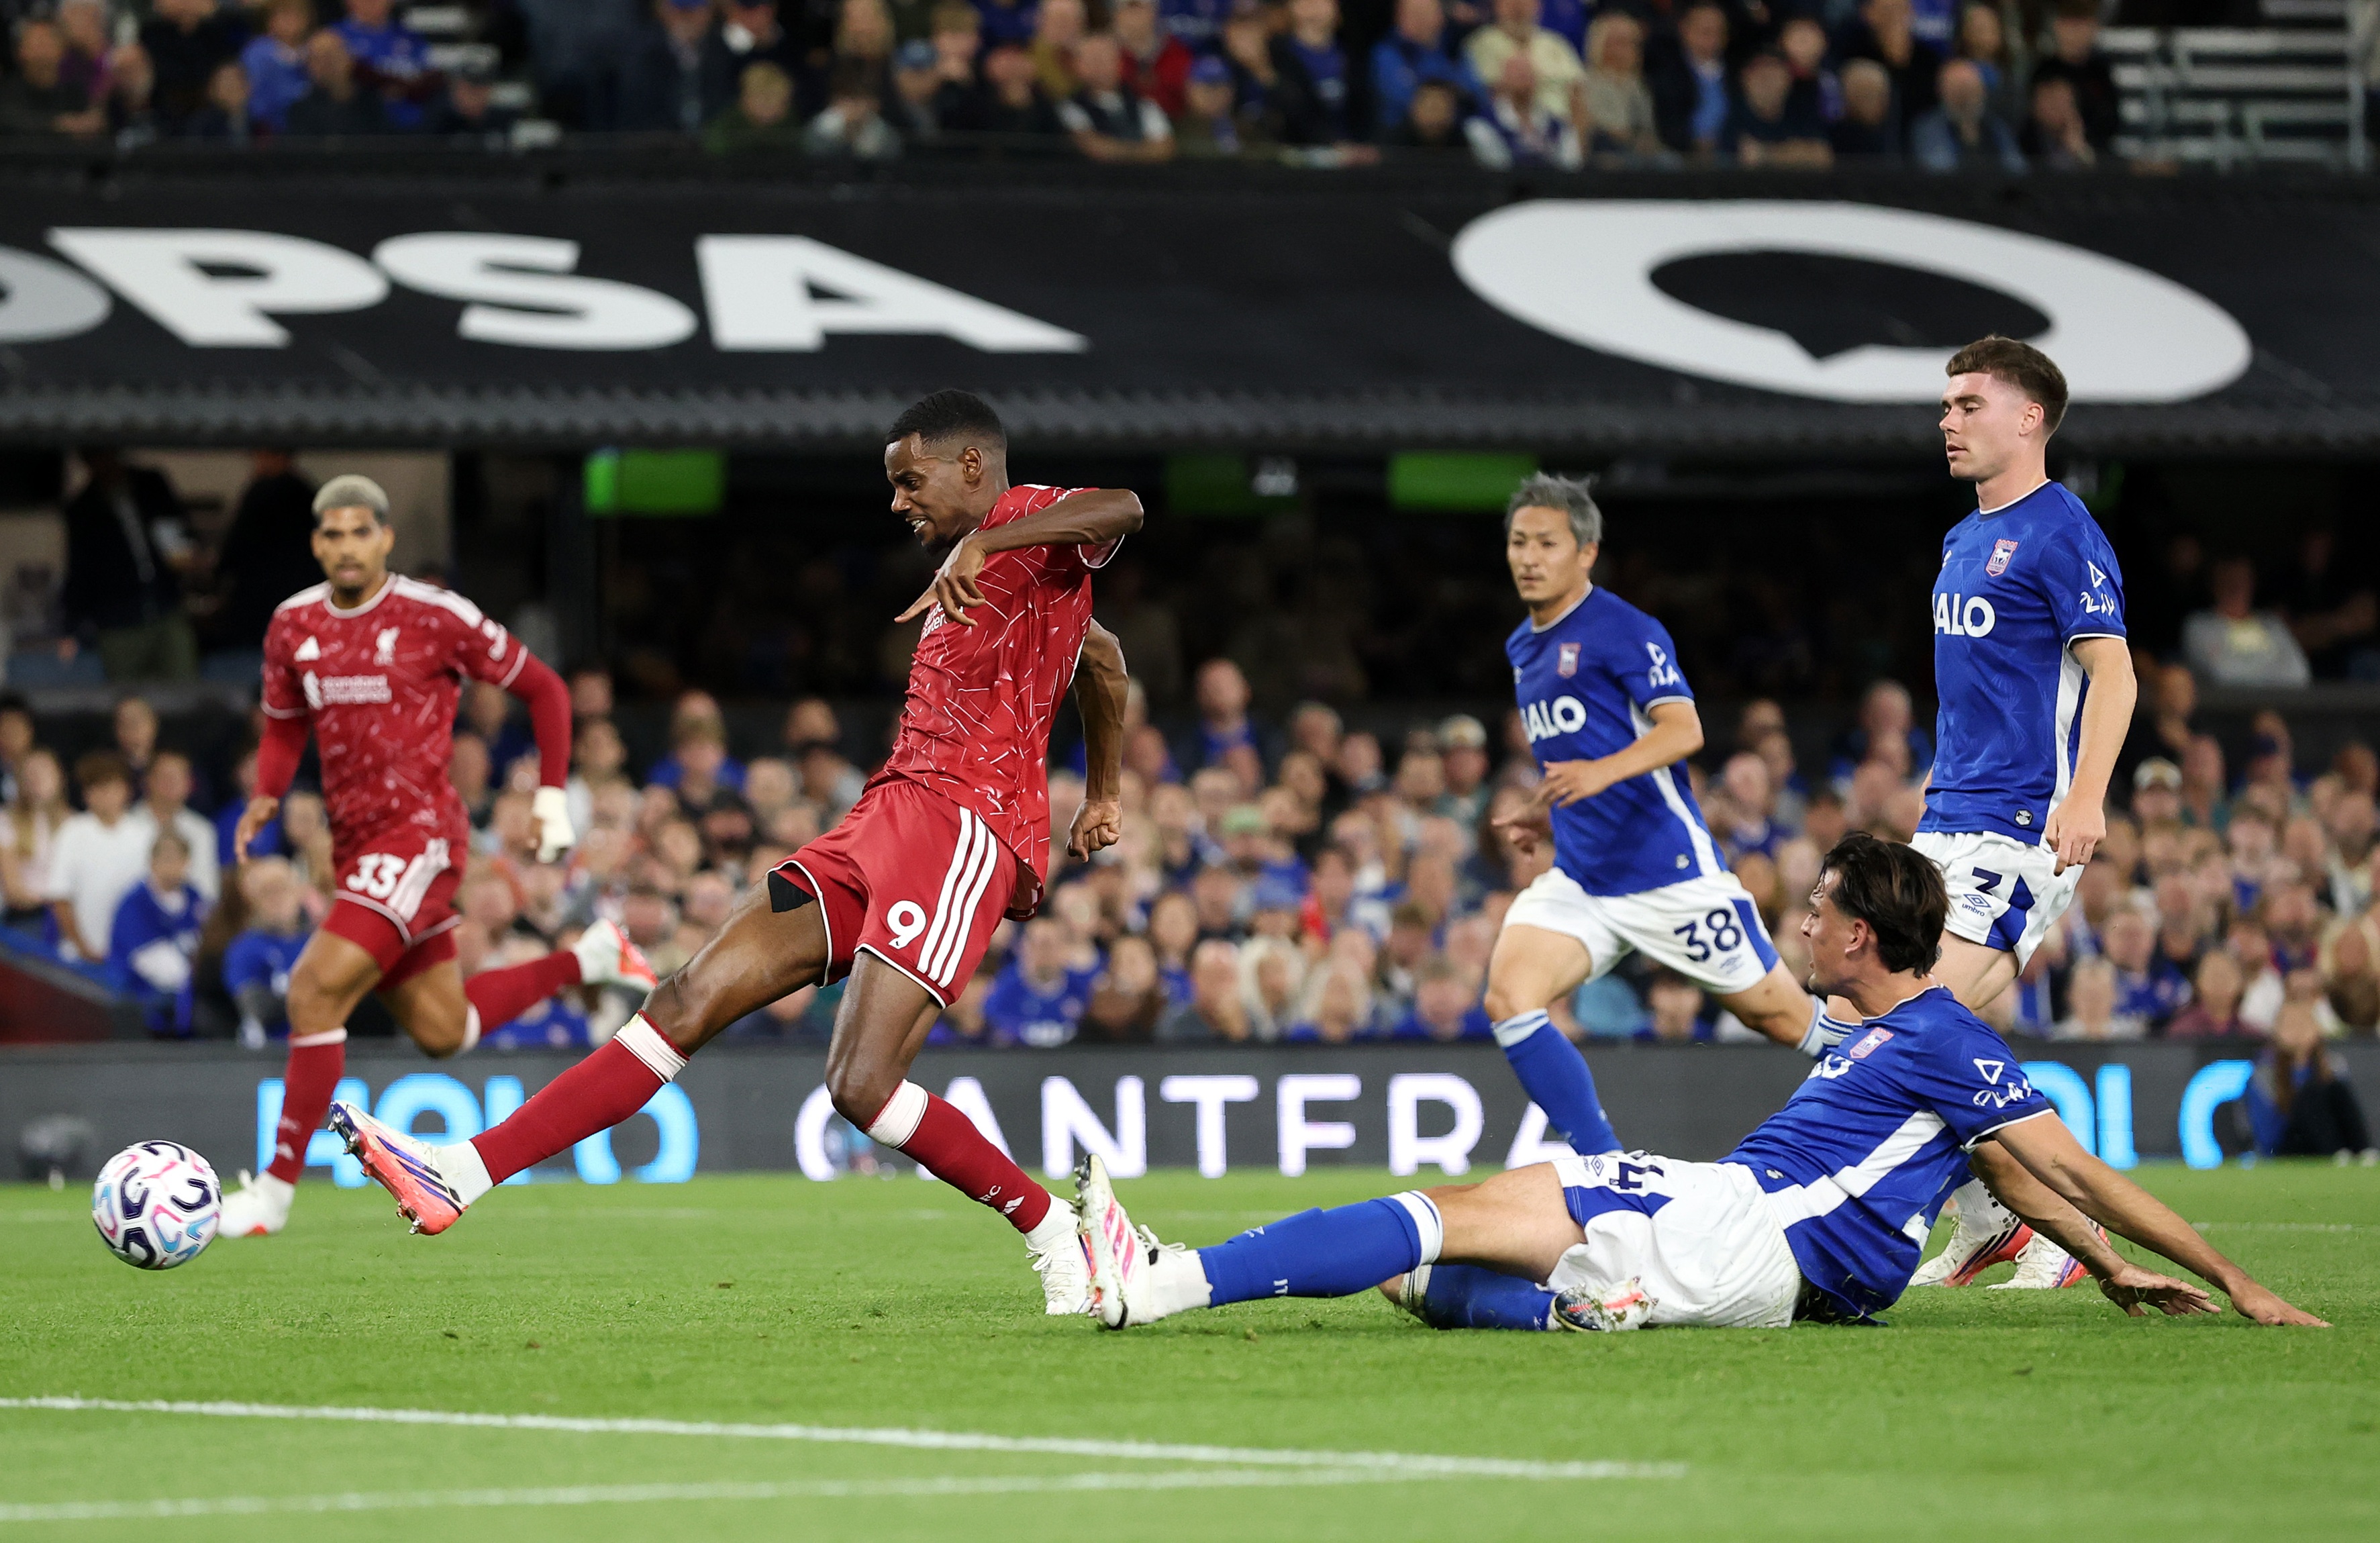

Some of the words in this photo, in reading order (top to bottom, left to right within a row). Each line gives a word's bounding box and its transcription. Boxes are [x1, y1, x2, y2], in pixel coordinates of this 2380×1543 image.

[1932, 592, 1995, 638] ALO
[346, 852, 407, 899] 33
[887, 899, 928, 950] 9
[1962, 903, 1985, 917] umbro
[1674, 909, 1741, 962] 38
